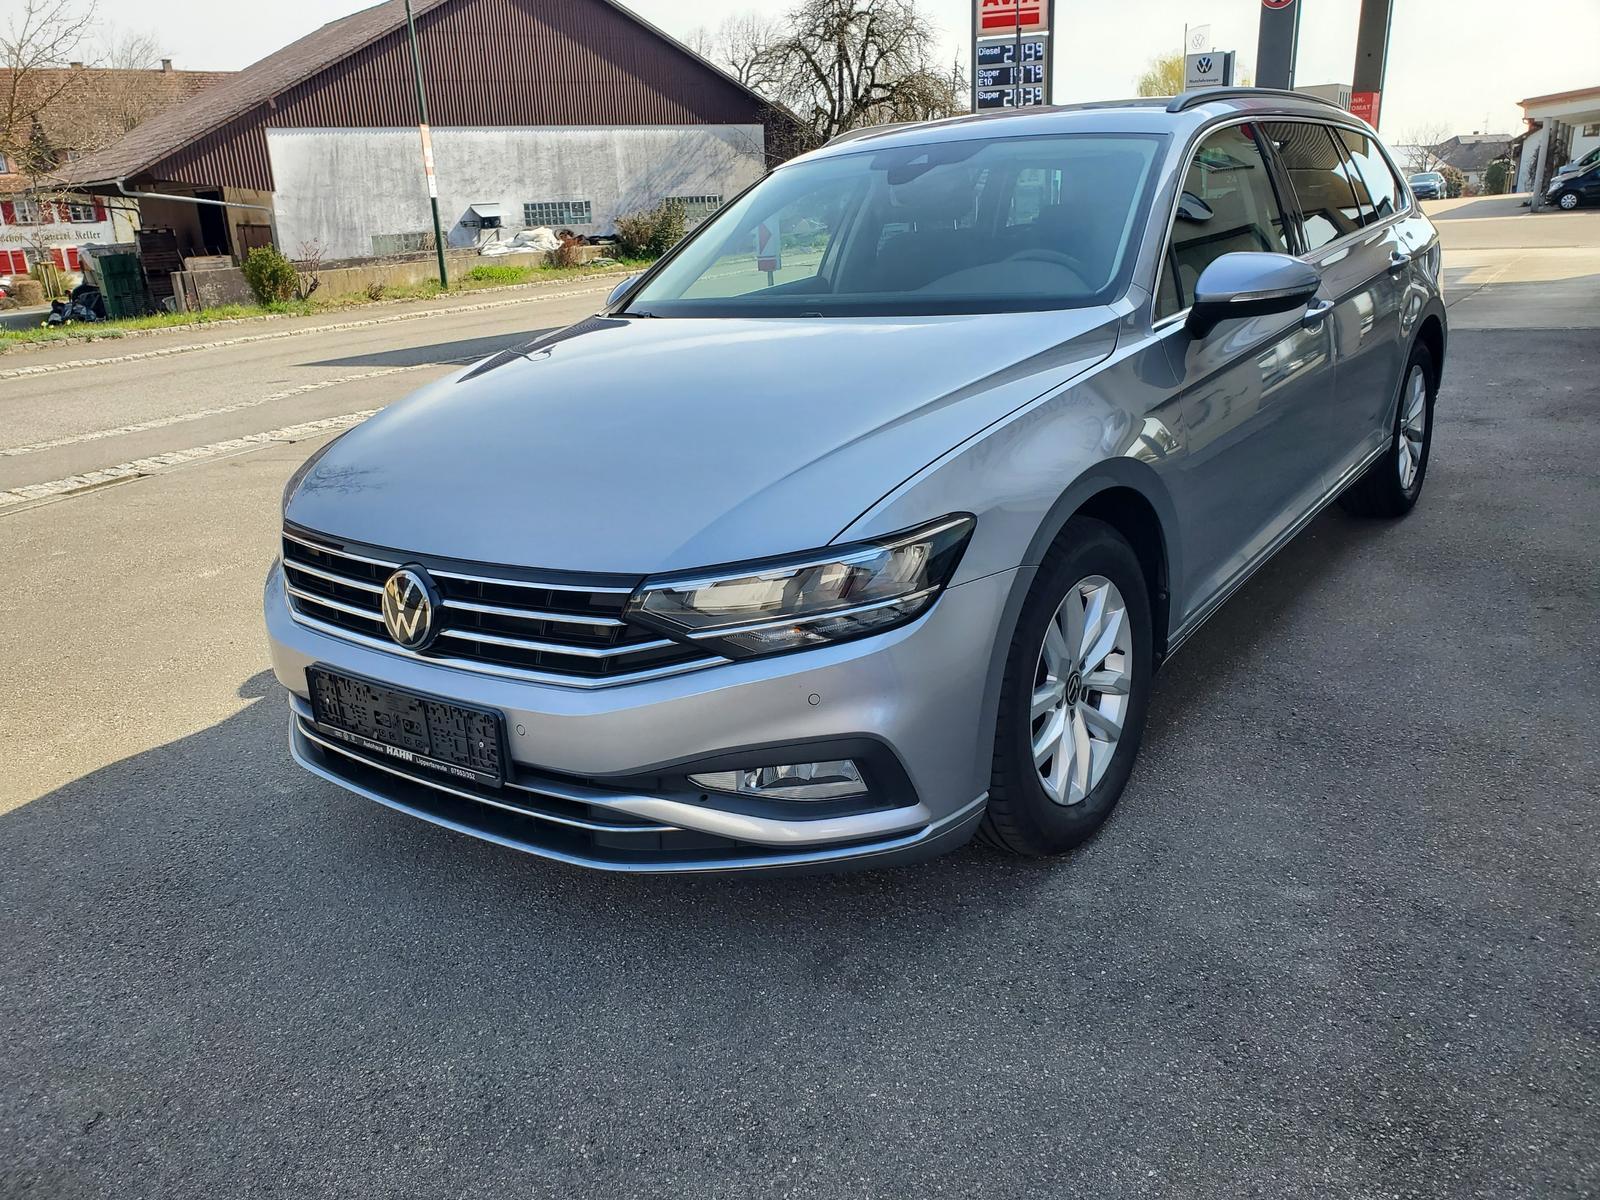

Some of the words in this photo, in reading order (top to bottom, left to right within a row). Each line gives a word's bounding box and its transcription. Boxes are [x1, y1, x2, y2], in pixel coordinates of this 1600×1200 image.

[979, 47, 1001, 56] Diesel
[978, 69, 1000, 79] Super
[978, 78, 993, 86] E10
[978, 91, 1000, 101] Super
[75, 229, 102, 240] Keller
[386, 745, 413, 762] HAHN
